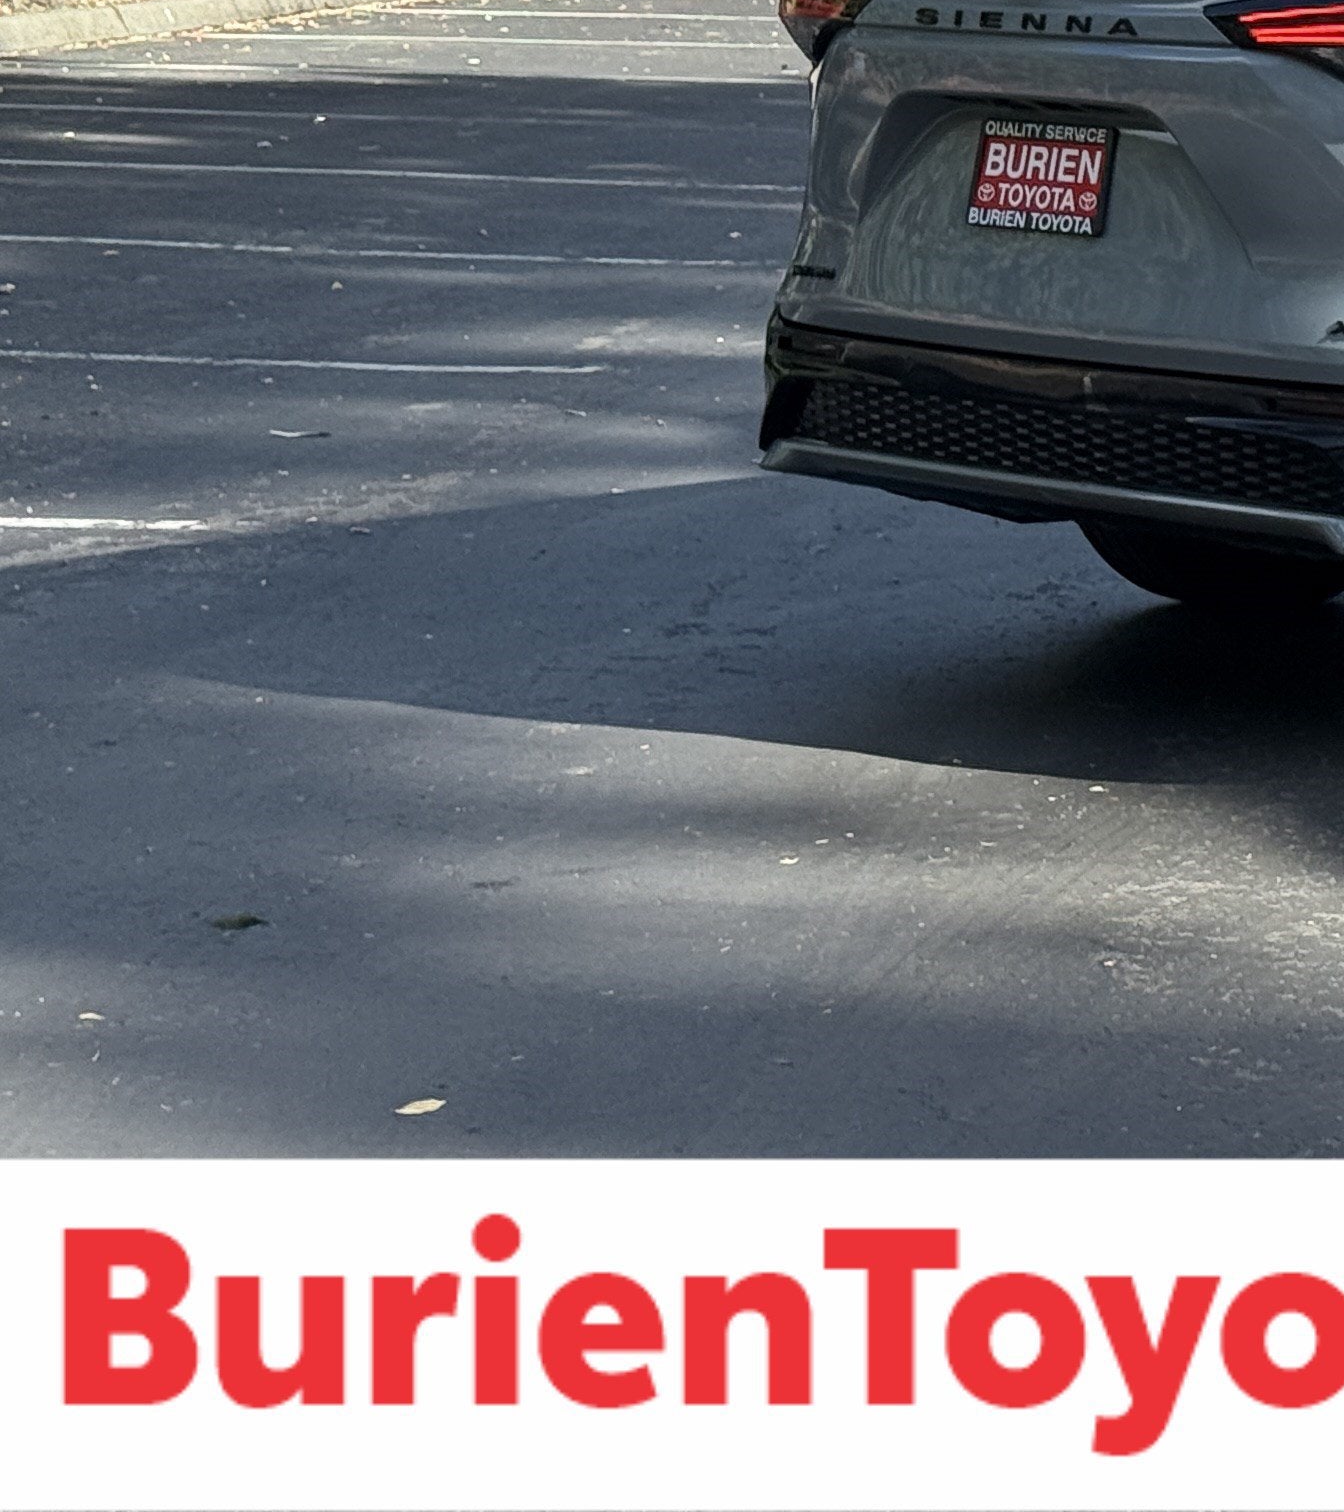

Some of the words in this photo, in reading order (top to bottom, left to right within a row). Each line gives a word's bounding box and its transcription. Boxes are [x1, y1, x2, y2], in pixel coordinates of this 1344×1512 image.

[914, 6, 1138, 37] SIENNA
[985, 120, 1044, 139] QUALITY
[984, 142, 1102, 185] BURIEN
[998, 183, 1075, 213] TOYOTA
[968, 207, 1026, 229] BURIEN
[1031, 212, 1093, 235] TOYOTA
